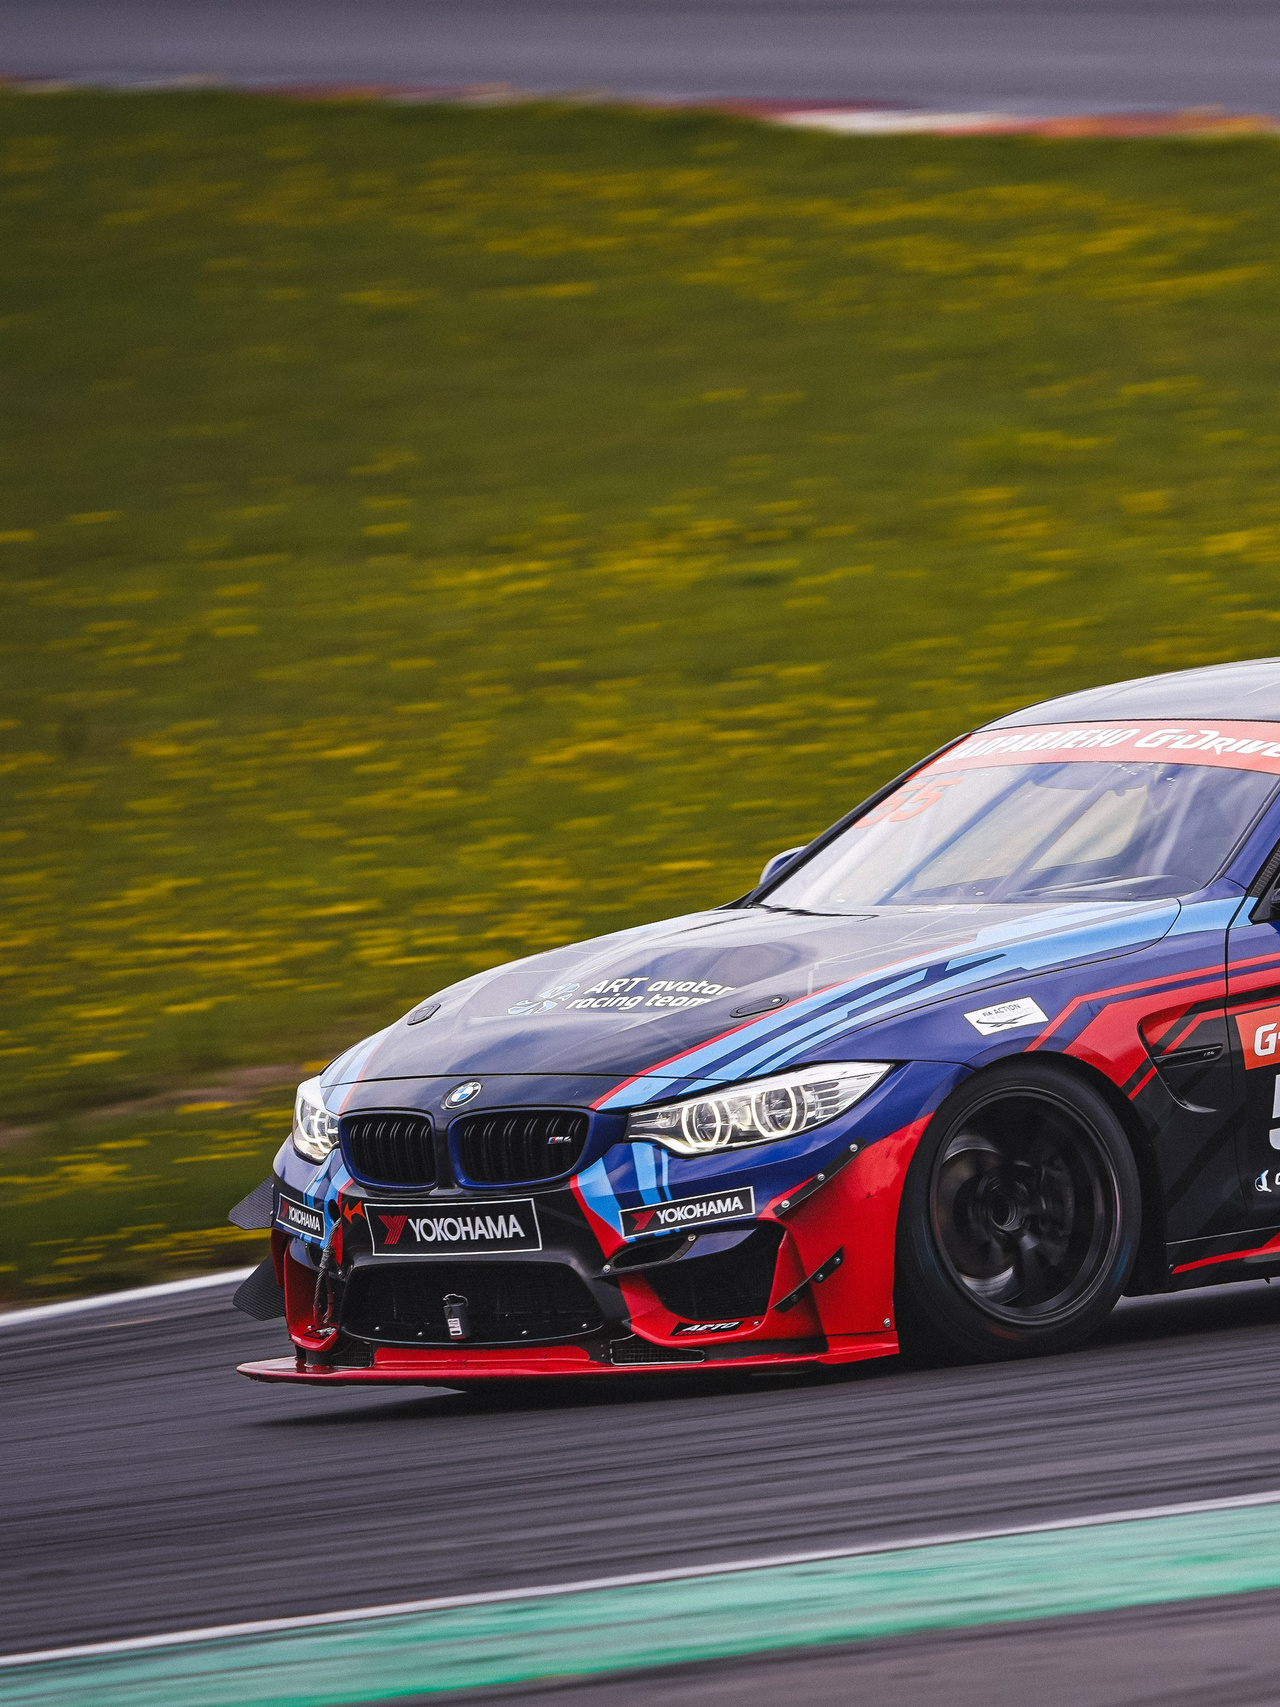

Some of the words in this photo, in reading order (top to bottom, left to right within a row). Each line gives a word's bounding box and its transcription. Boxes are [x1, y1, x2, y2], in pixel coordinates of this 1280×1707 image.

[583, 976, 650, 994] ART
[647, 979, 736, 996] avatar
[565, 993, 645, 1011] racing
[644, 994, 713, 1007] team
[288, 1205, 320, 1231] YOKOHAMA
[656, 1196, 744, 1225] YOKOHAMA
[408, 1214, 525, 1242] YOKOHAMA
